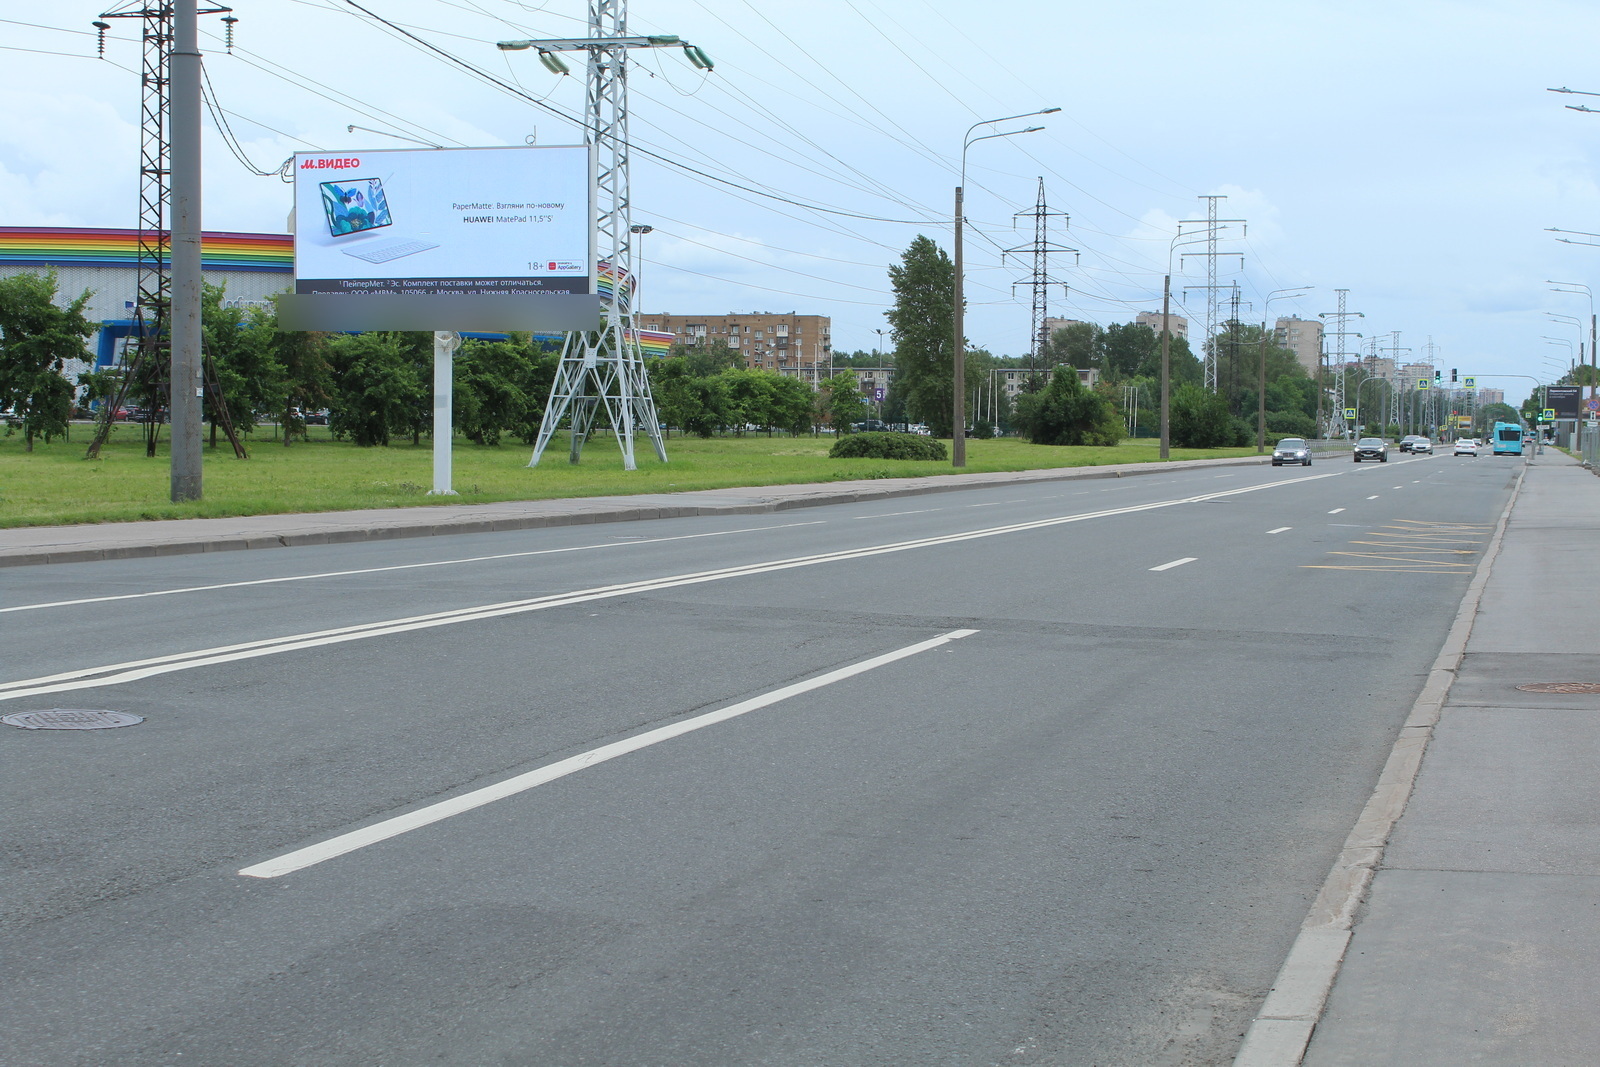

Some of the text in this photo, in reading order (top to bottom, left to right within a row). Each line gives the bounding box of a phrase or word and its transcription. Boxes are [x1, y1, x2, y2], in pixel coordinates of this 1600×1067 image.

[301, 158, 360, 169] М.ВИДЕО
[496, 202, 525, 210] Взгляни
[527, 203, 565, 211] по-новому
[528, 261, 544, 270] 18+
[402, 280, 438, 288] Комплект
[500, 279, 544, 287] отличаться.
[876, 390, 882, 399] 5
